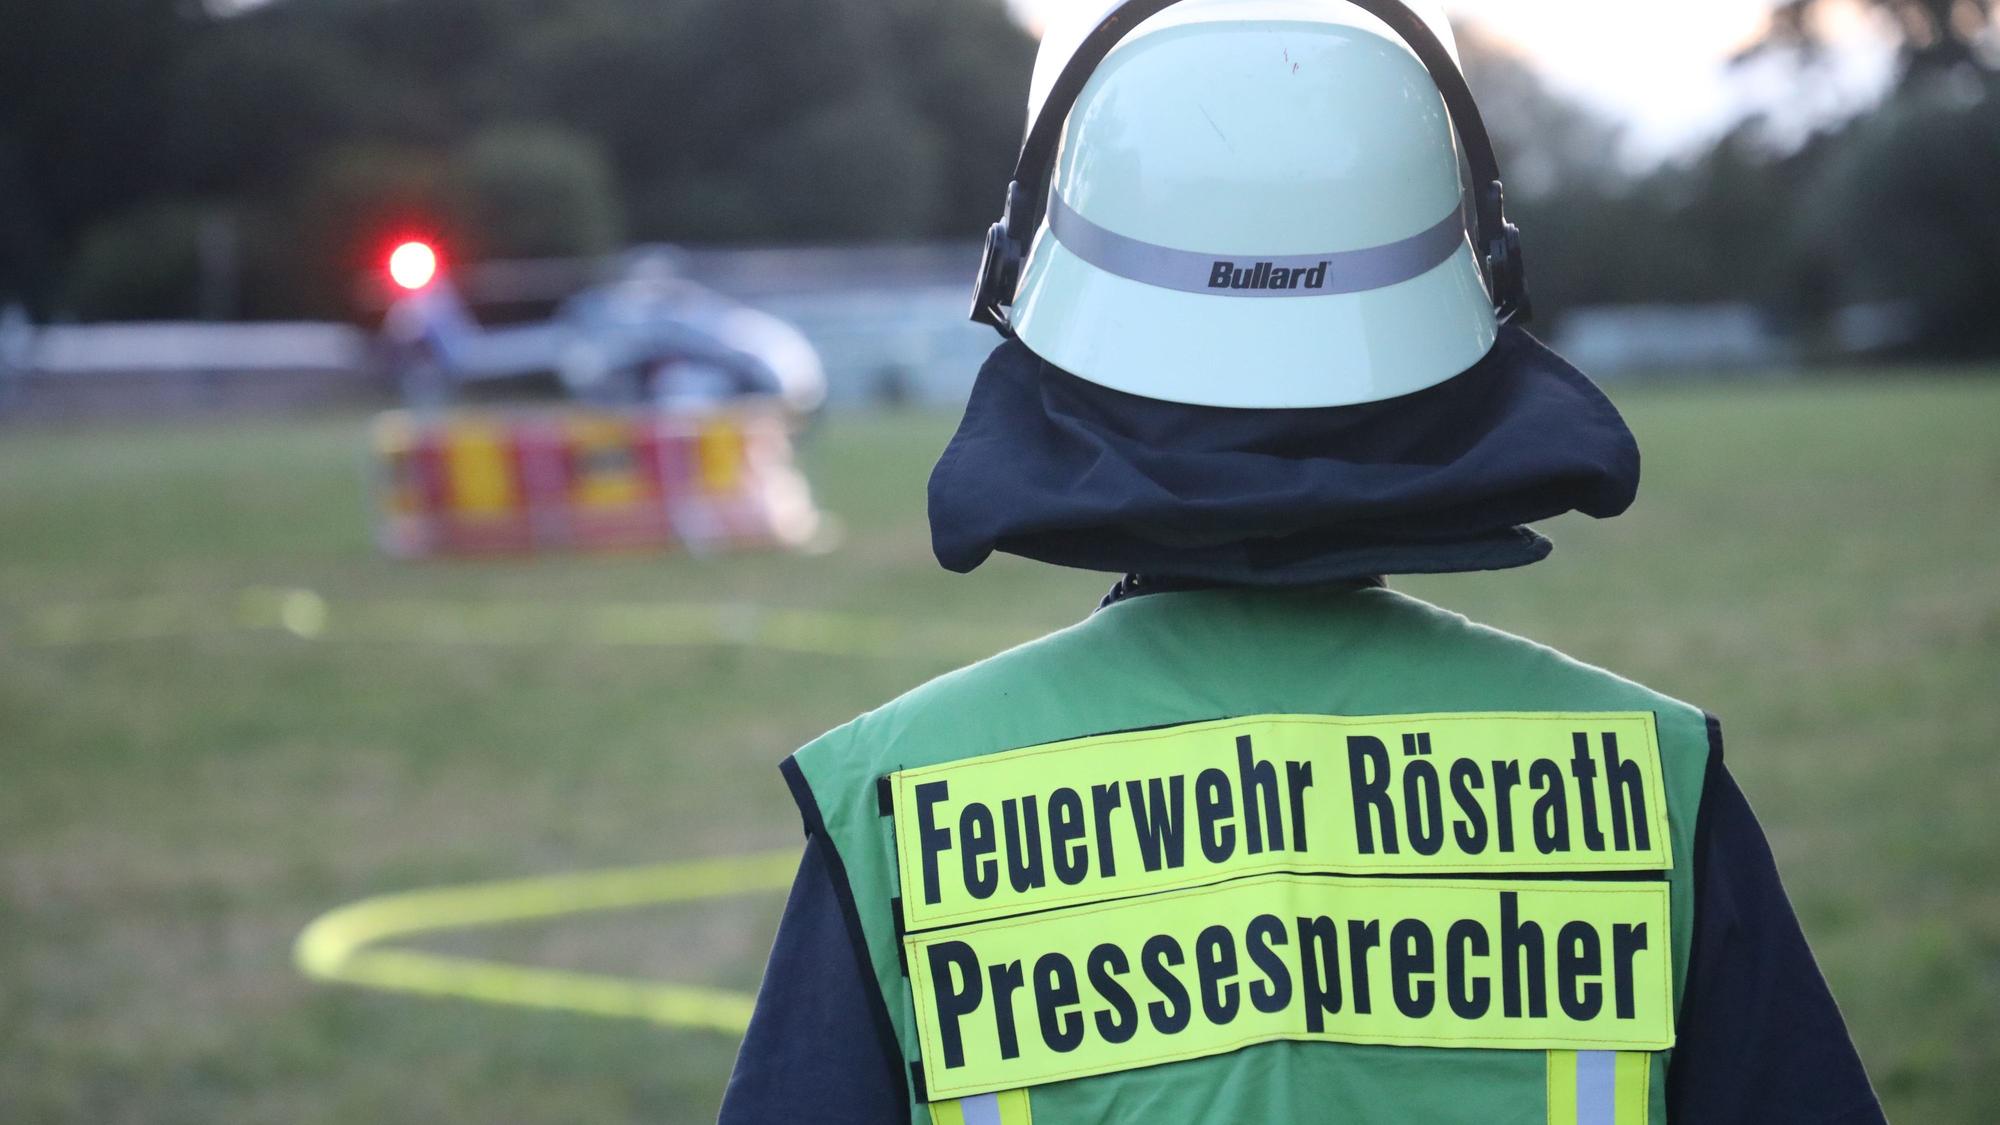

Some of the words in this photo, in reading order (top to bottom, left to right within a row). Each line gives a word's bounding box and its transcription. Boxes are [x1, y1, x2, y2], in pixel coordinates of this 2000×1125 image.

[1207, 261, 1328, 290] Bullard
[915, 735, 1313, 905] Feuerwehr
[1346, 732, 1651, 856] Rösrath
[926, 891, 1648, 1069] Pressesprecher
